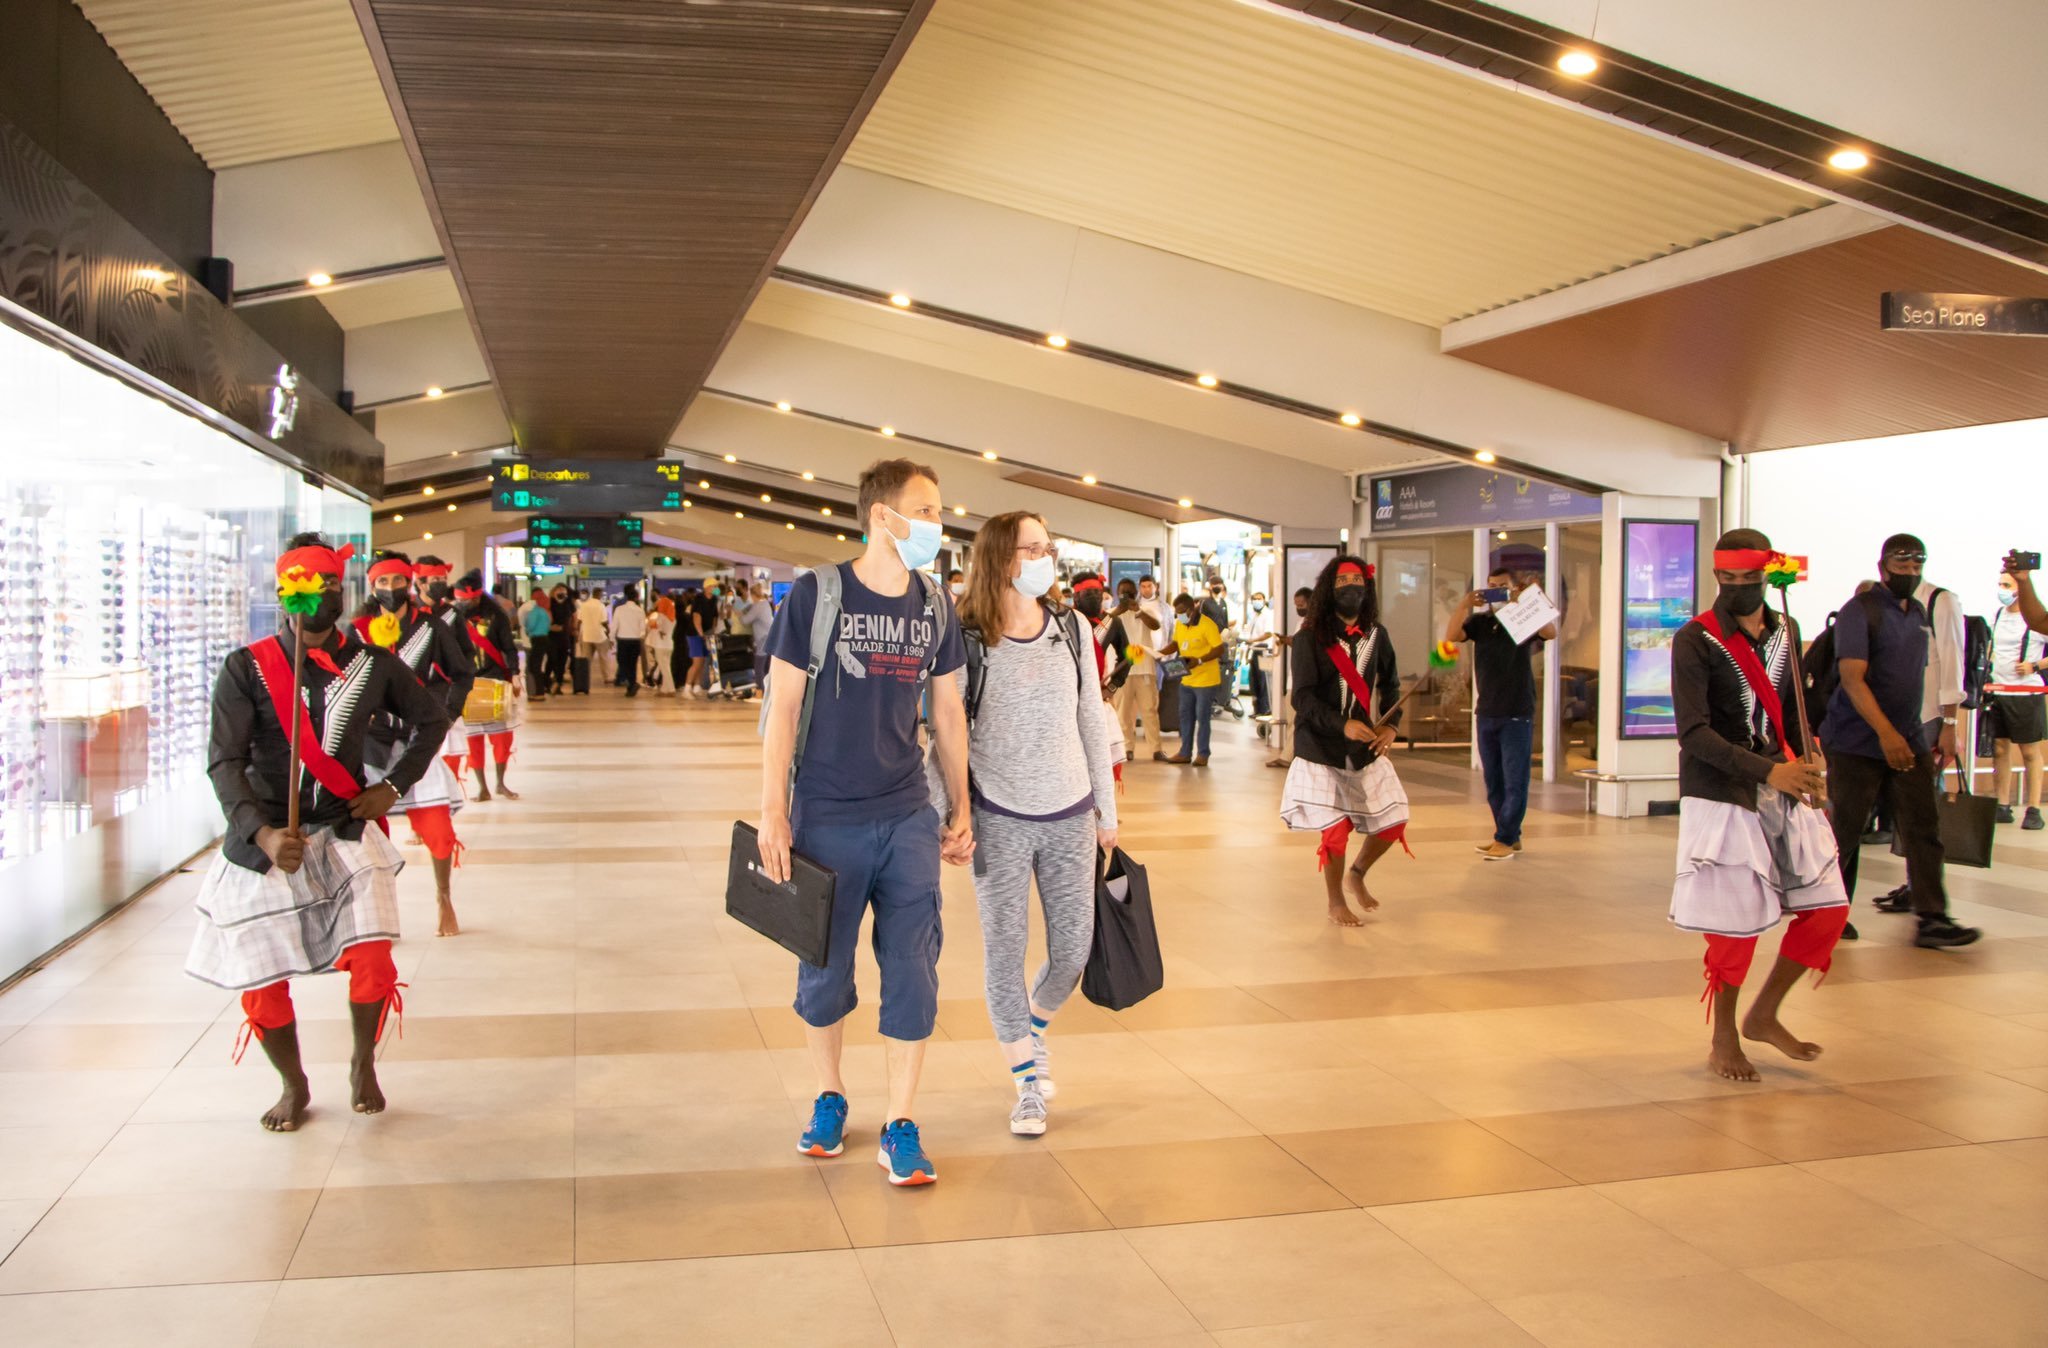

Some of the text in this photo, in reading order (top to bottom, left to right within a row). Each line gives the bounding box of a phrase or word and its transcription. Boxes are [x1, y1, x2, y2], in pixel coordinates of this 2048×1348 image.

[1902, 305, 1986, 327] Sea Plane
[530, 468, 590, 481] Departures
[840, 613, 906, 644] DENIM
[851, 640, 925, 658] MADE IN 1969
